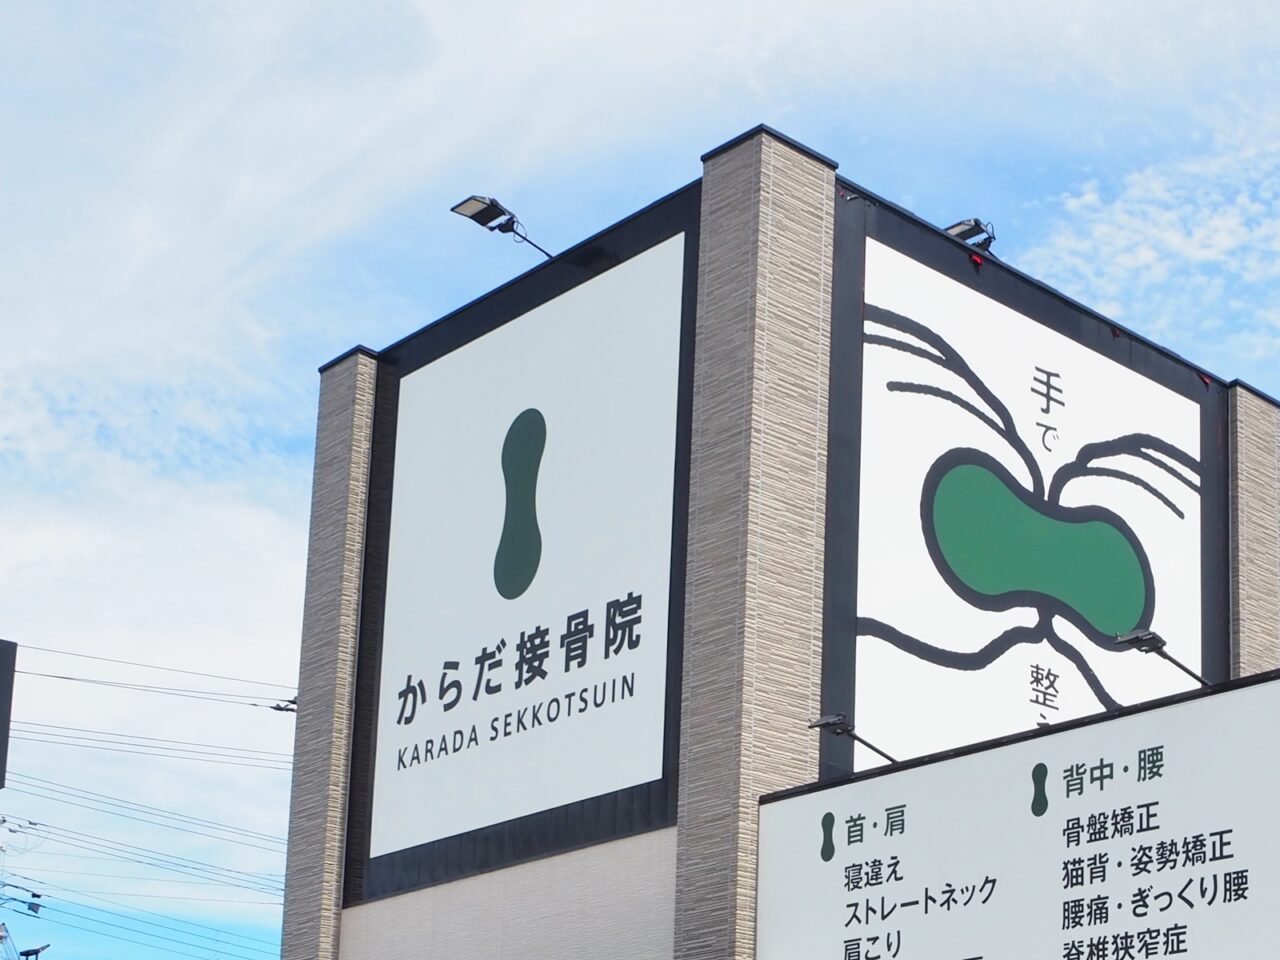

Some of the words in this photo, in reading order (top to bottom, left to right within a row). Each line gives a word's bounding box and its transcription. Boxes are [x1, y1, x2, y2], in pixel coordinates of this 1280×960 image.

[1030, 366, 1065, 453] 手で
[396, 592, 642, 726] からだ接骨院
[397, 729, 479, 771] KARADA
[489, 673, 635, 742] SEKKOTSUIN
[1063, 745, 1165, 798] 背中・腰
[845, 804, 907, 846] 首・肩
[1062, 801, 1161, 848] 骨盤矯正
[843, 856, 904, 892] 寝違え
[1061, 829, 1234, 889] 猫背・姿勢矯正
[845, 875, 998, 928] ストレートネック
[1061, 869, 1250, 930] 腰痛・ぎっくり腰
